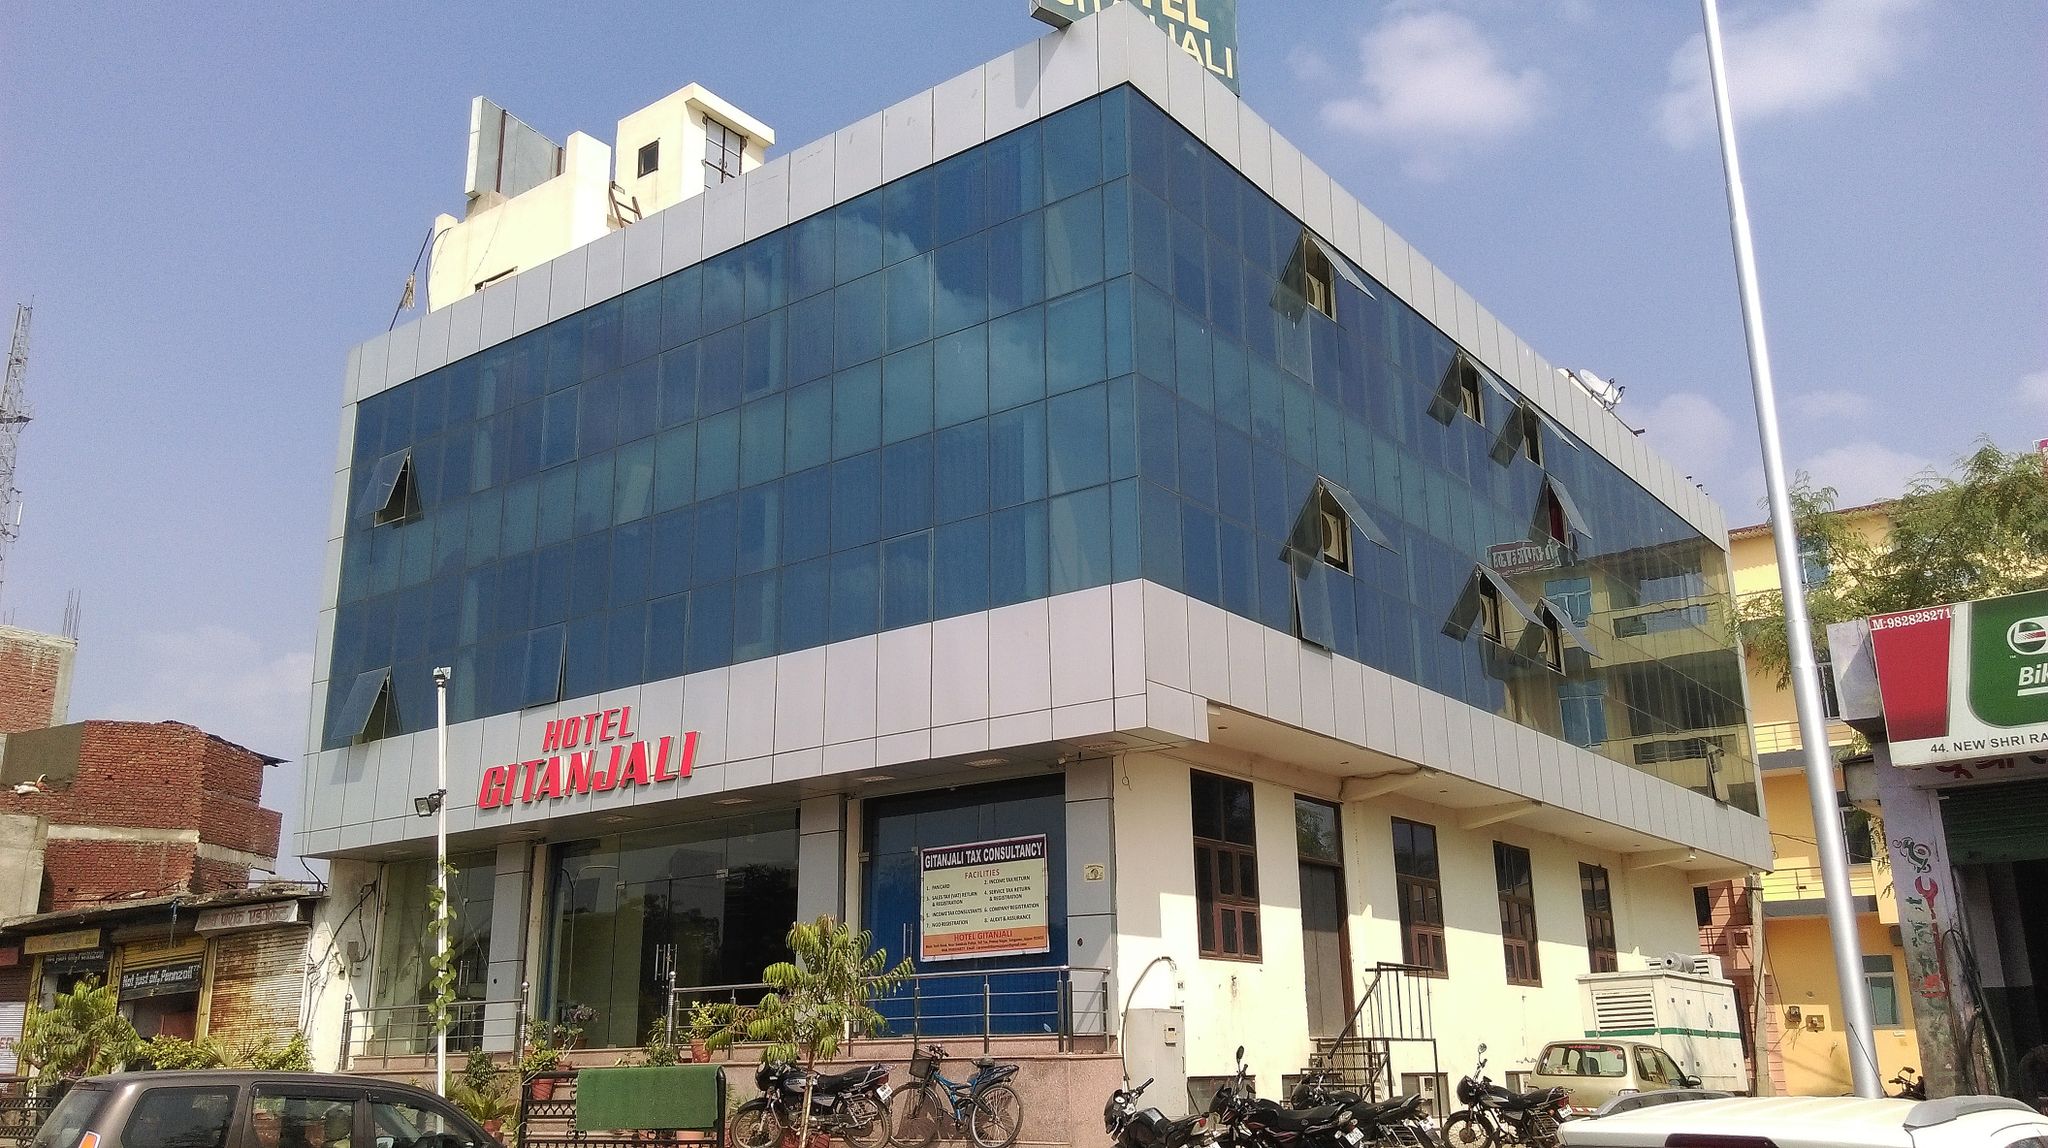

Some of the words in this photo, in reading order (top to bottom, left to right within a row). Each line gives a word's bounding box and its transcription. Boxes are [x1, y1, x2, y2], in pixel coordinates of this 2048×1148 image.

[542, 705, 636, 752] HOTEL
[1930, 744, 1949, 752] 44.
[1954, 740, 1985, 752] NEW
[1990, 736, 2025, 748] SHRI
[478, 731, 702, 809] GITANJALI
[925, 851, 964, 868] GITANJALI
[966, 848, 982, 864] TAX
[983, 842, 1042, 861] CONSULTANCY
[964, 868, 1000, 880] FACILITIES
[954, 933, 976, 941] HOTEL
[977, 930, 1012, 940] GITANJALI
